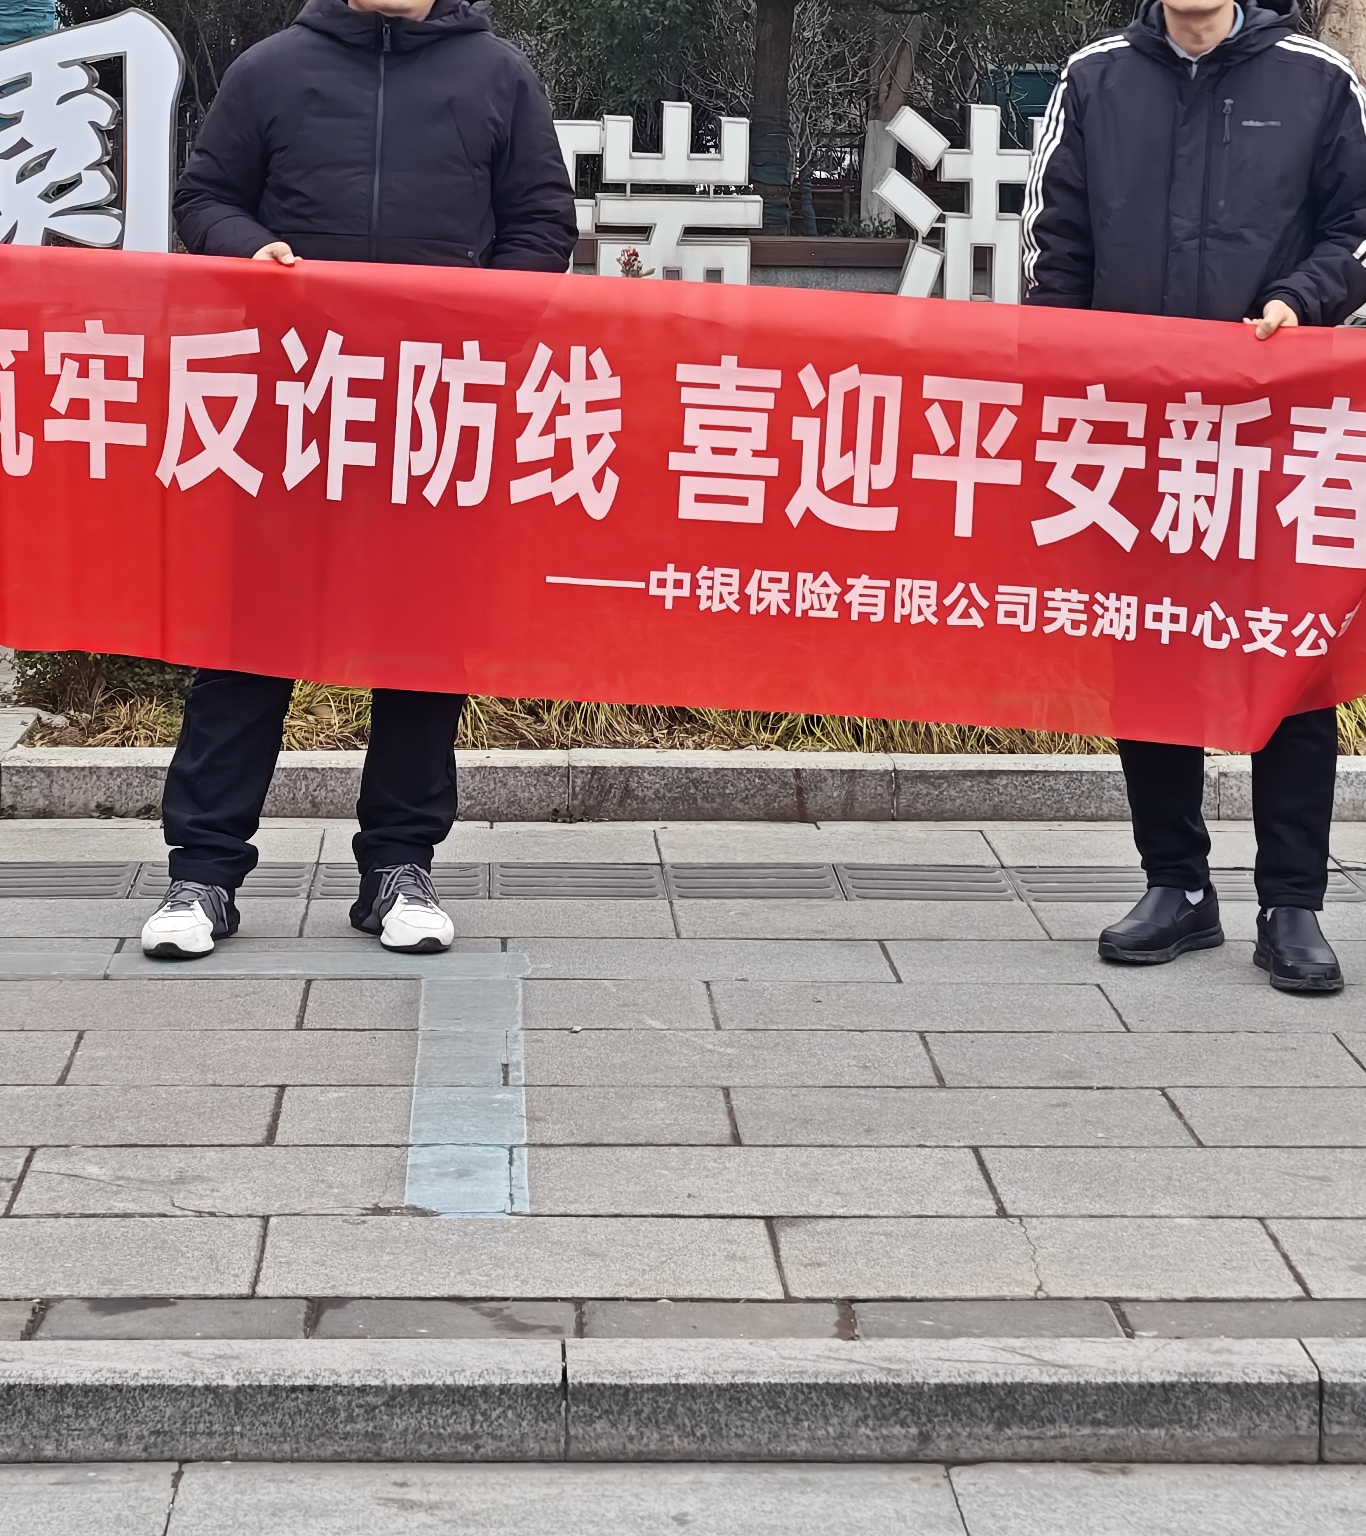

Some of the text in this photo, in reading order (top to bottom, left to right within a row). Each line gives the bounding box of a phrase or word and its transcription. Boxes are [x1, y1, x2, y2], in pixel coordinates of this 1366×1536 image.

[546, 564, 1360, 658] ——中银保险有限公司芜湖中心支公
